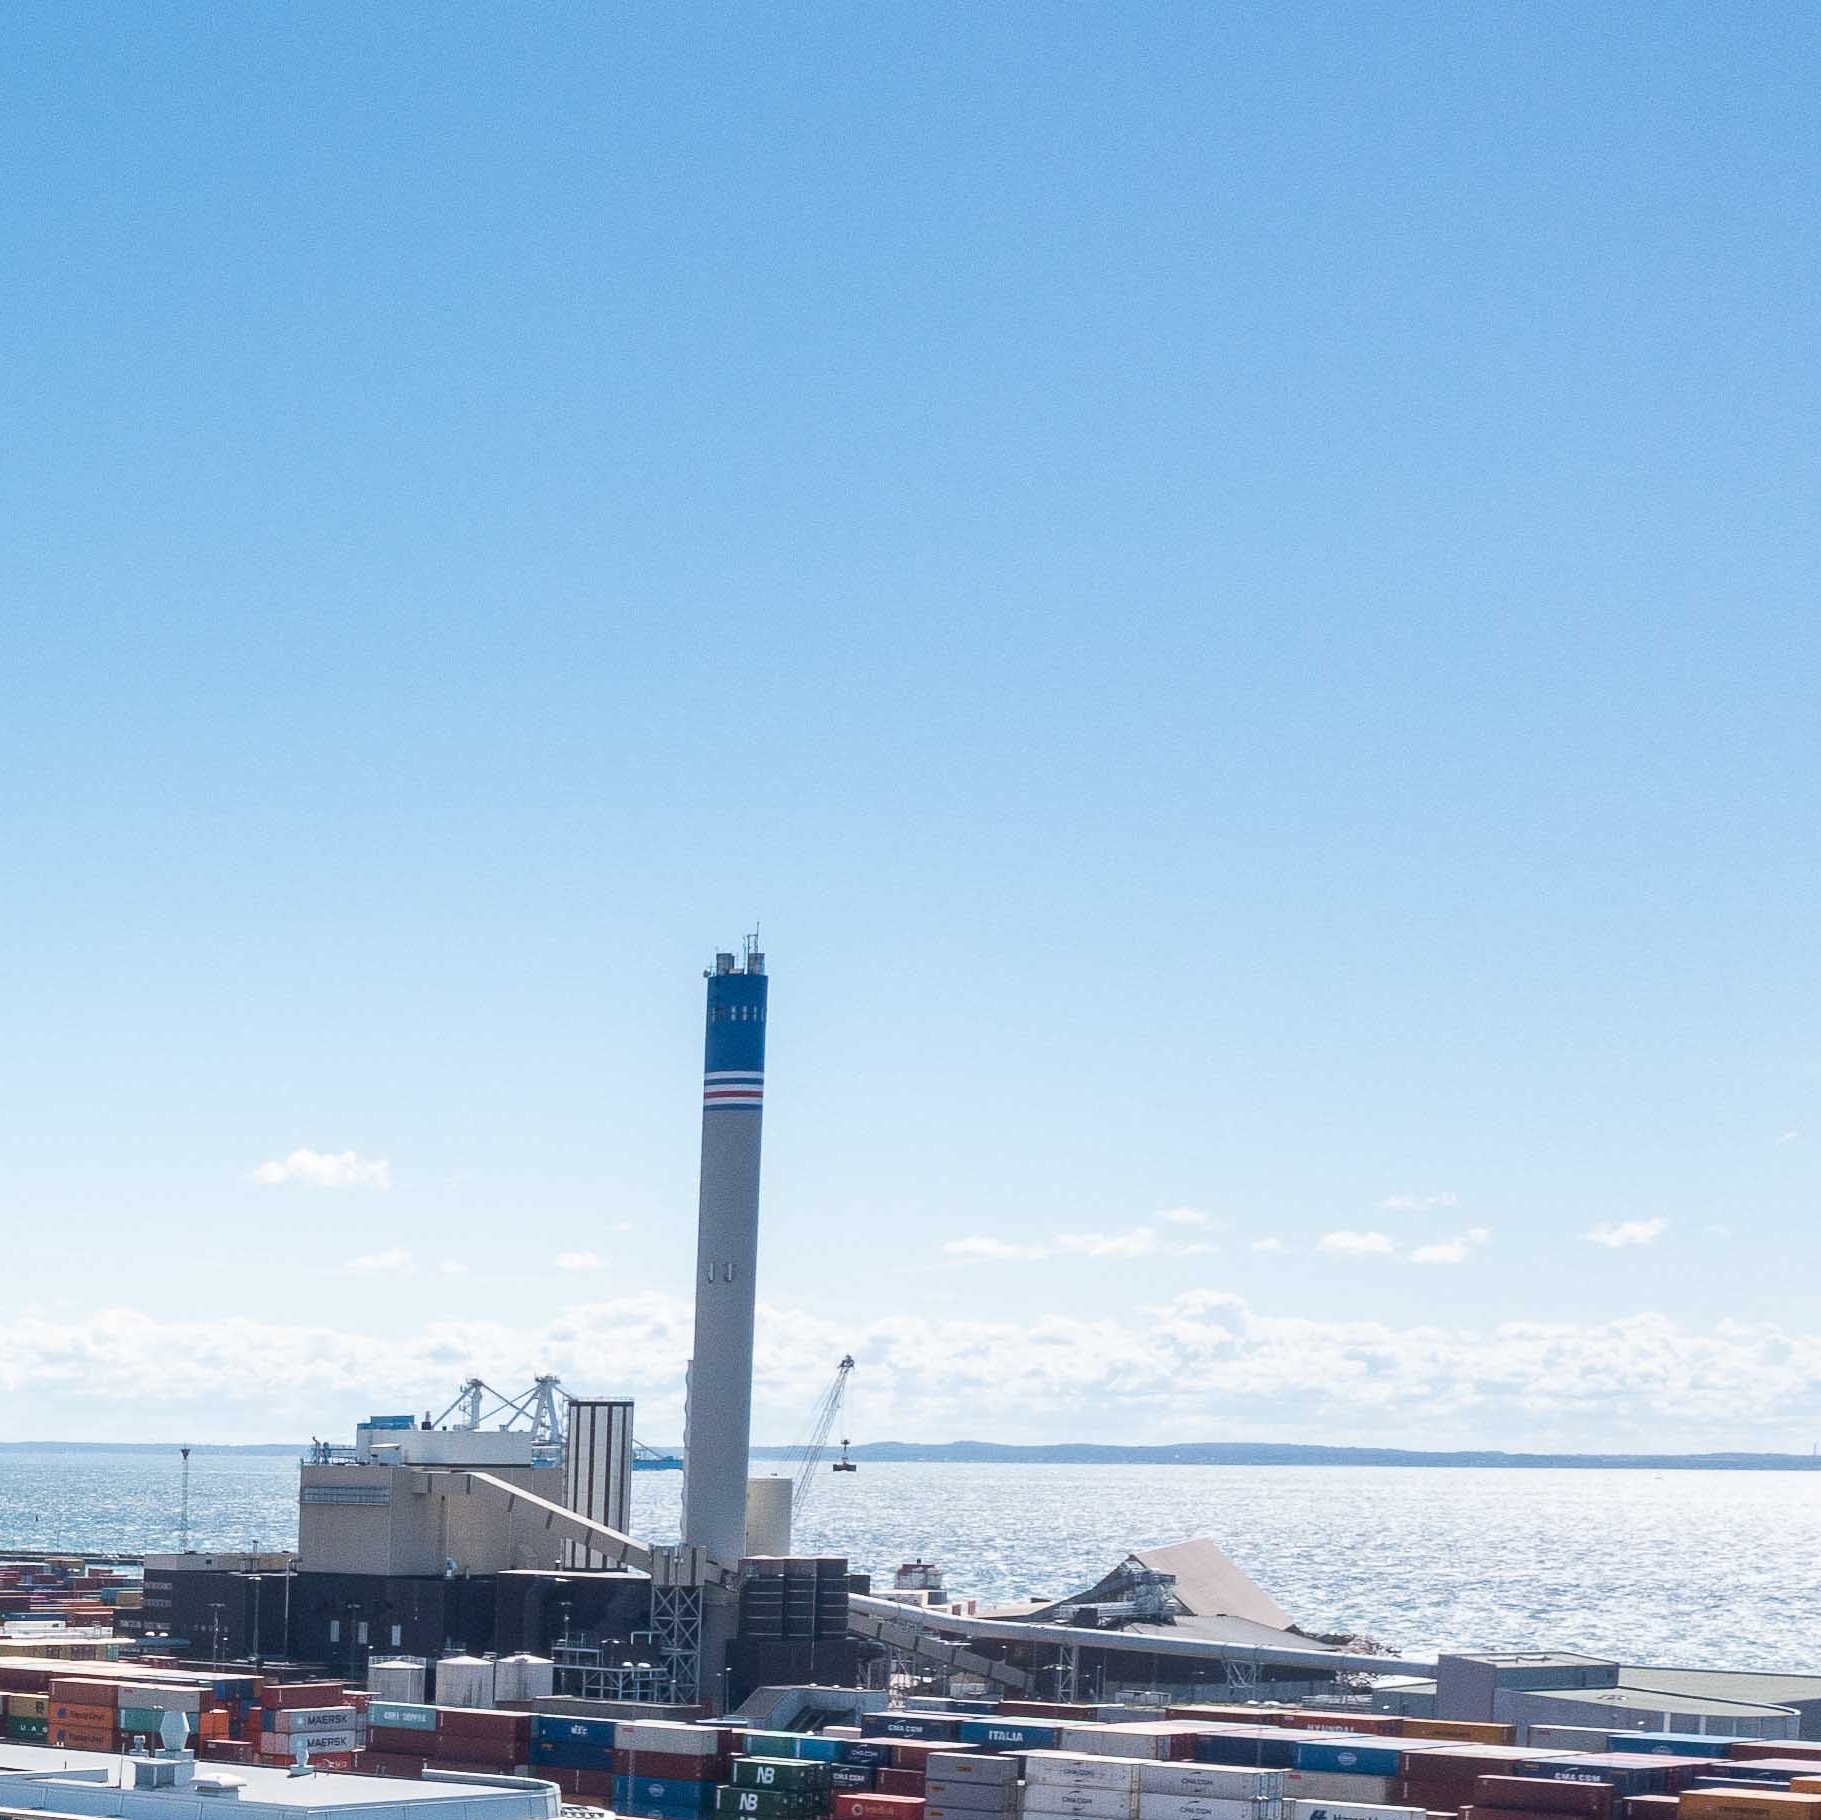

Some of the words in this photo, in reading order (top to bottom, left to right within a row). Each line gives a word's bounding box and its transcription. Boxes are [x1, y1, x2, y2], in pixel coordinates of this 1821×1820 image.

[307, 1714, 348, 1725] MAERSK
[988, 1730, 1024, 1742] ITALIA
[307, 1737, 347, 1748] MAERSK
